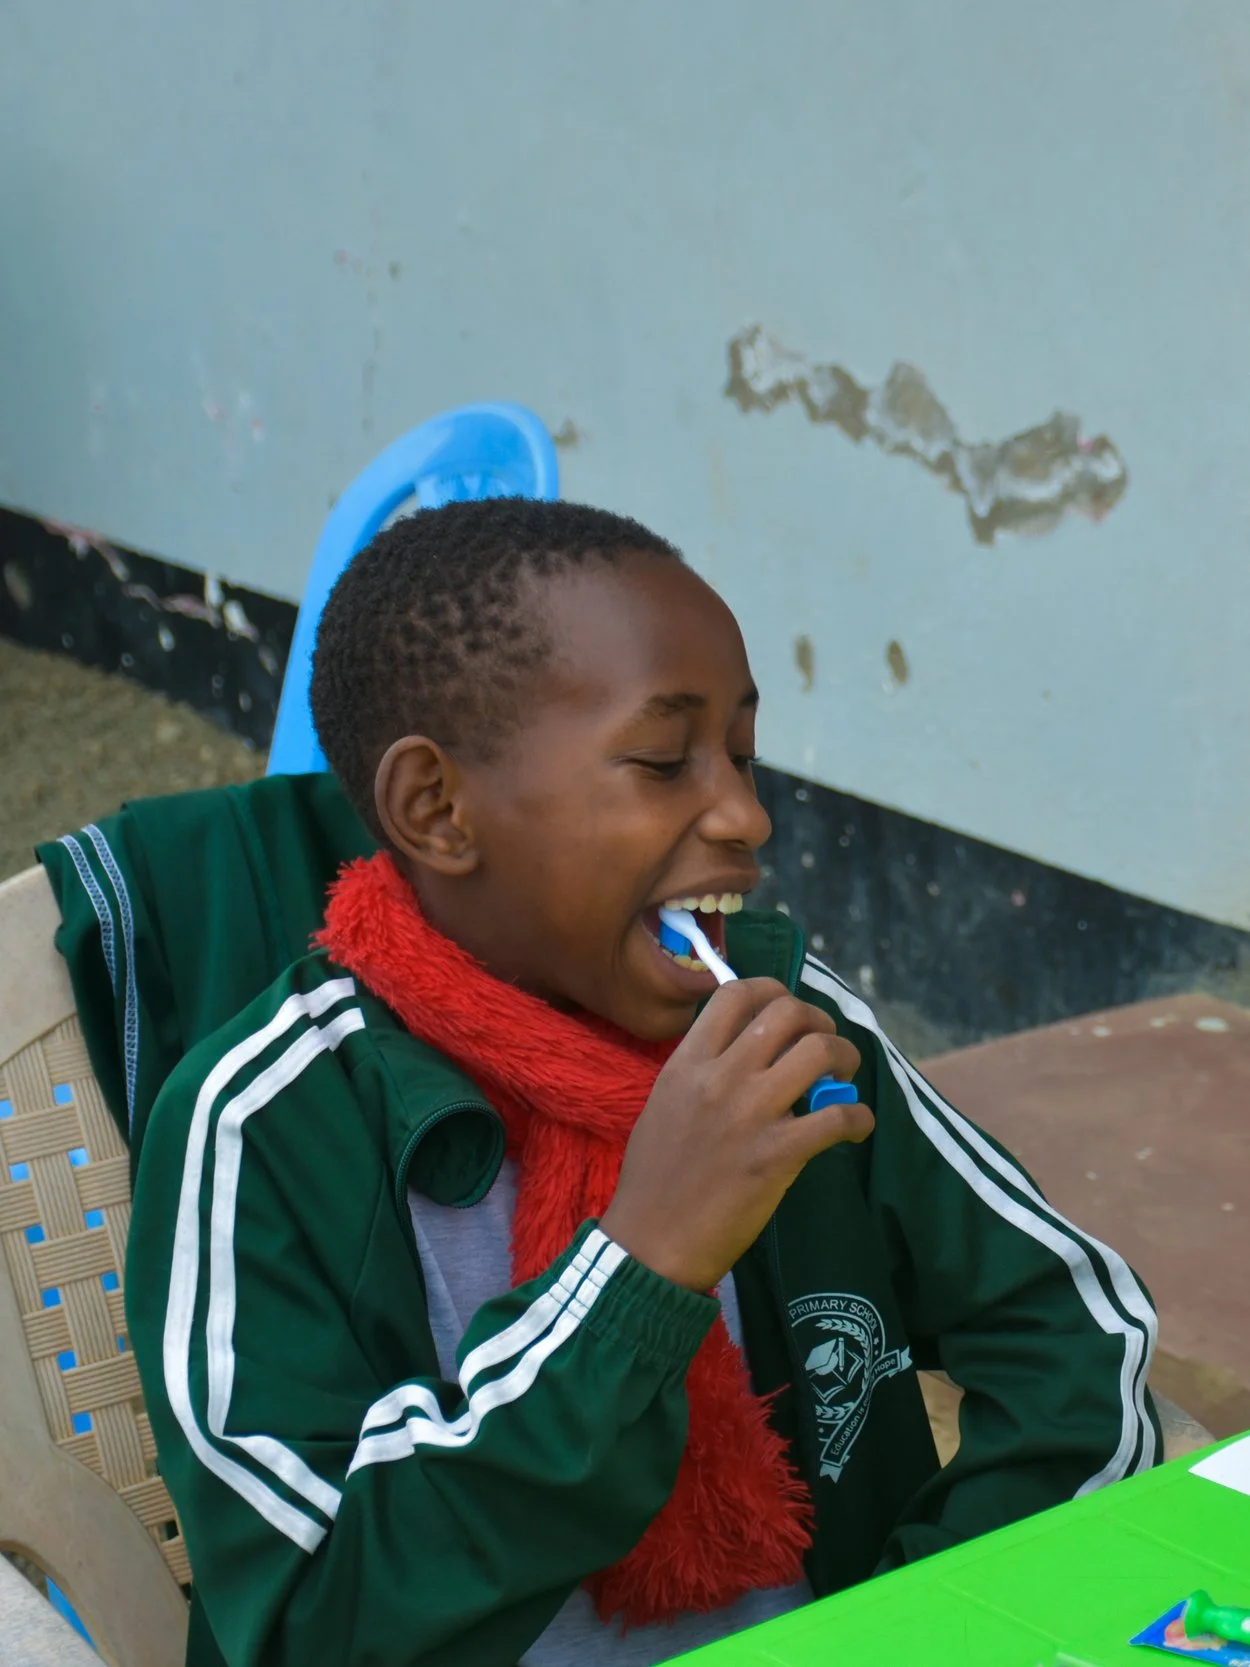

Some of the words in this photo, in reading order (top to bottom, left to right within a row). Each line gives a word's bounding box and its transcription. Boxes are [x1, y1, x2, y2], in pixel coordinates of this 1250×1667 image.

[789, 1299, 848, 1319] PRIMARY
[849, 1302, 878, 1332] SCHOOL
[874, 1357, 896, 1375] Hope
[831, 1414, 861, 1456] Education
